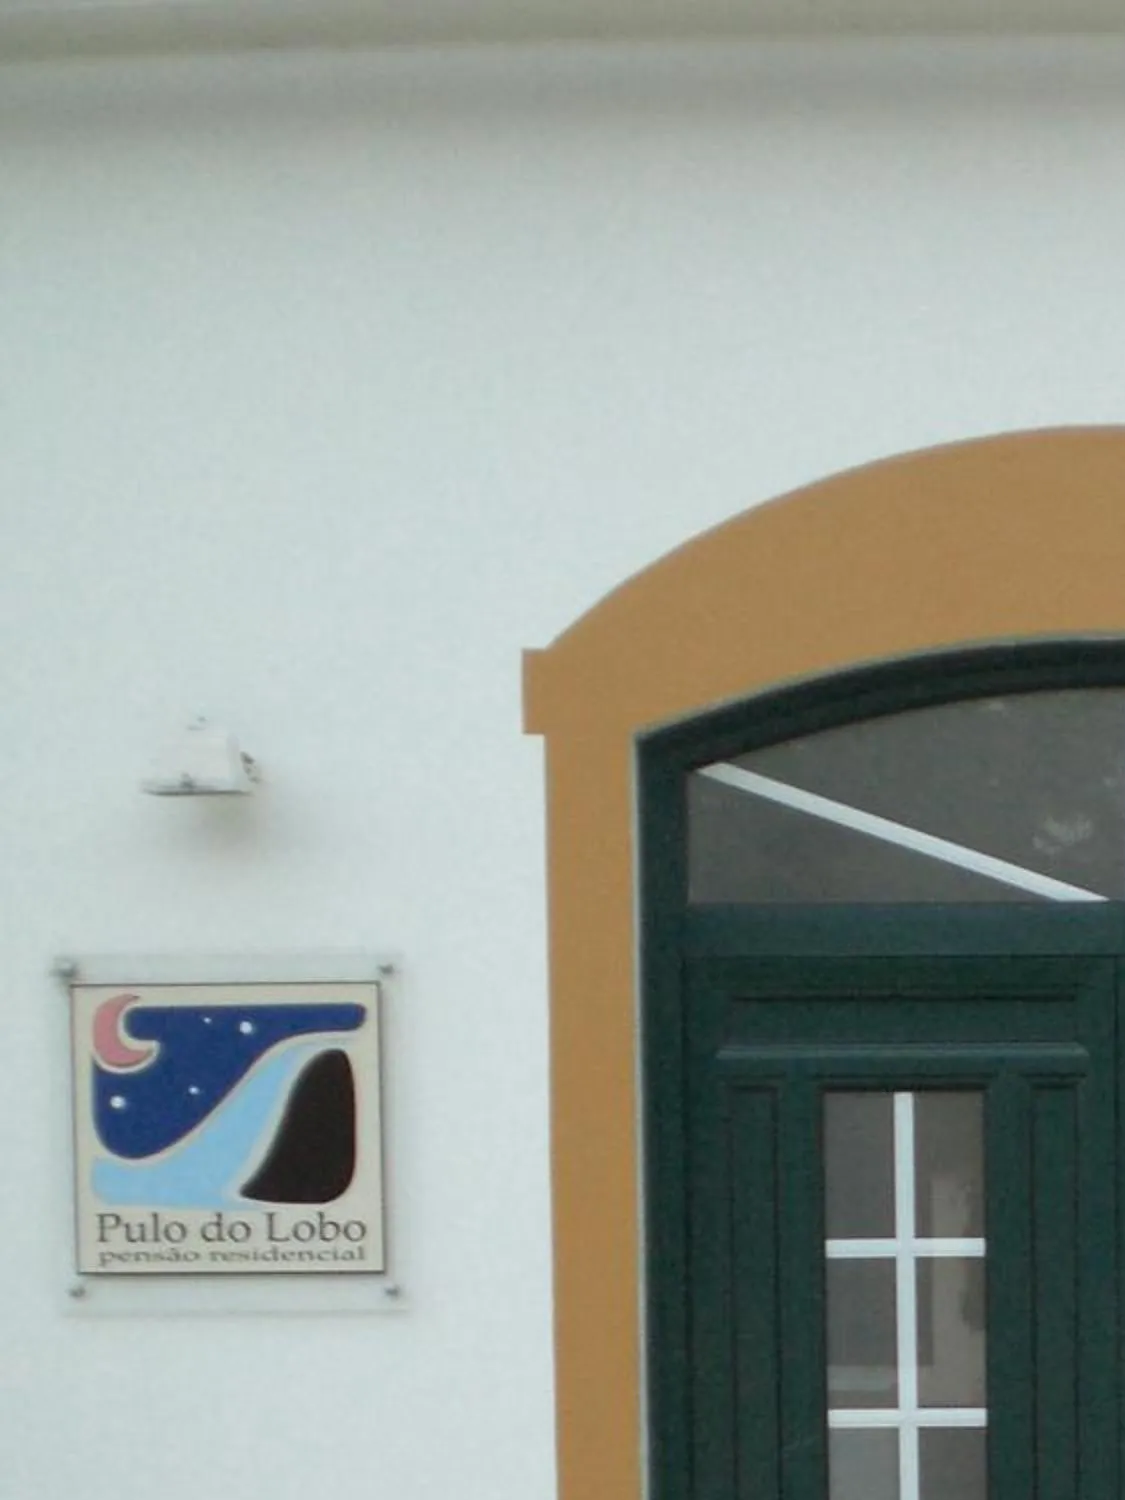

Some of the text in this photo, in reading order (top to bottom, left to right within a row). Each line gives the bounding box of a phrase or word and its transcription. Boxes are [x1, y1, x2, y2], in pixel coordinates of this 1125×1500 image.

[96, 1211, 367, 1243] Pulo do Lobo
[99, 1245, 366, 1267] pensão residencial
